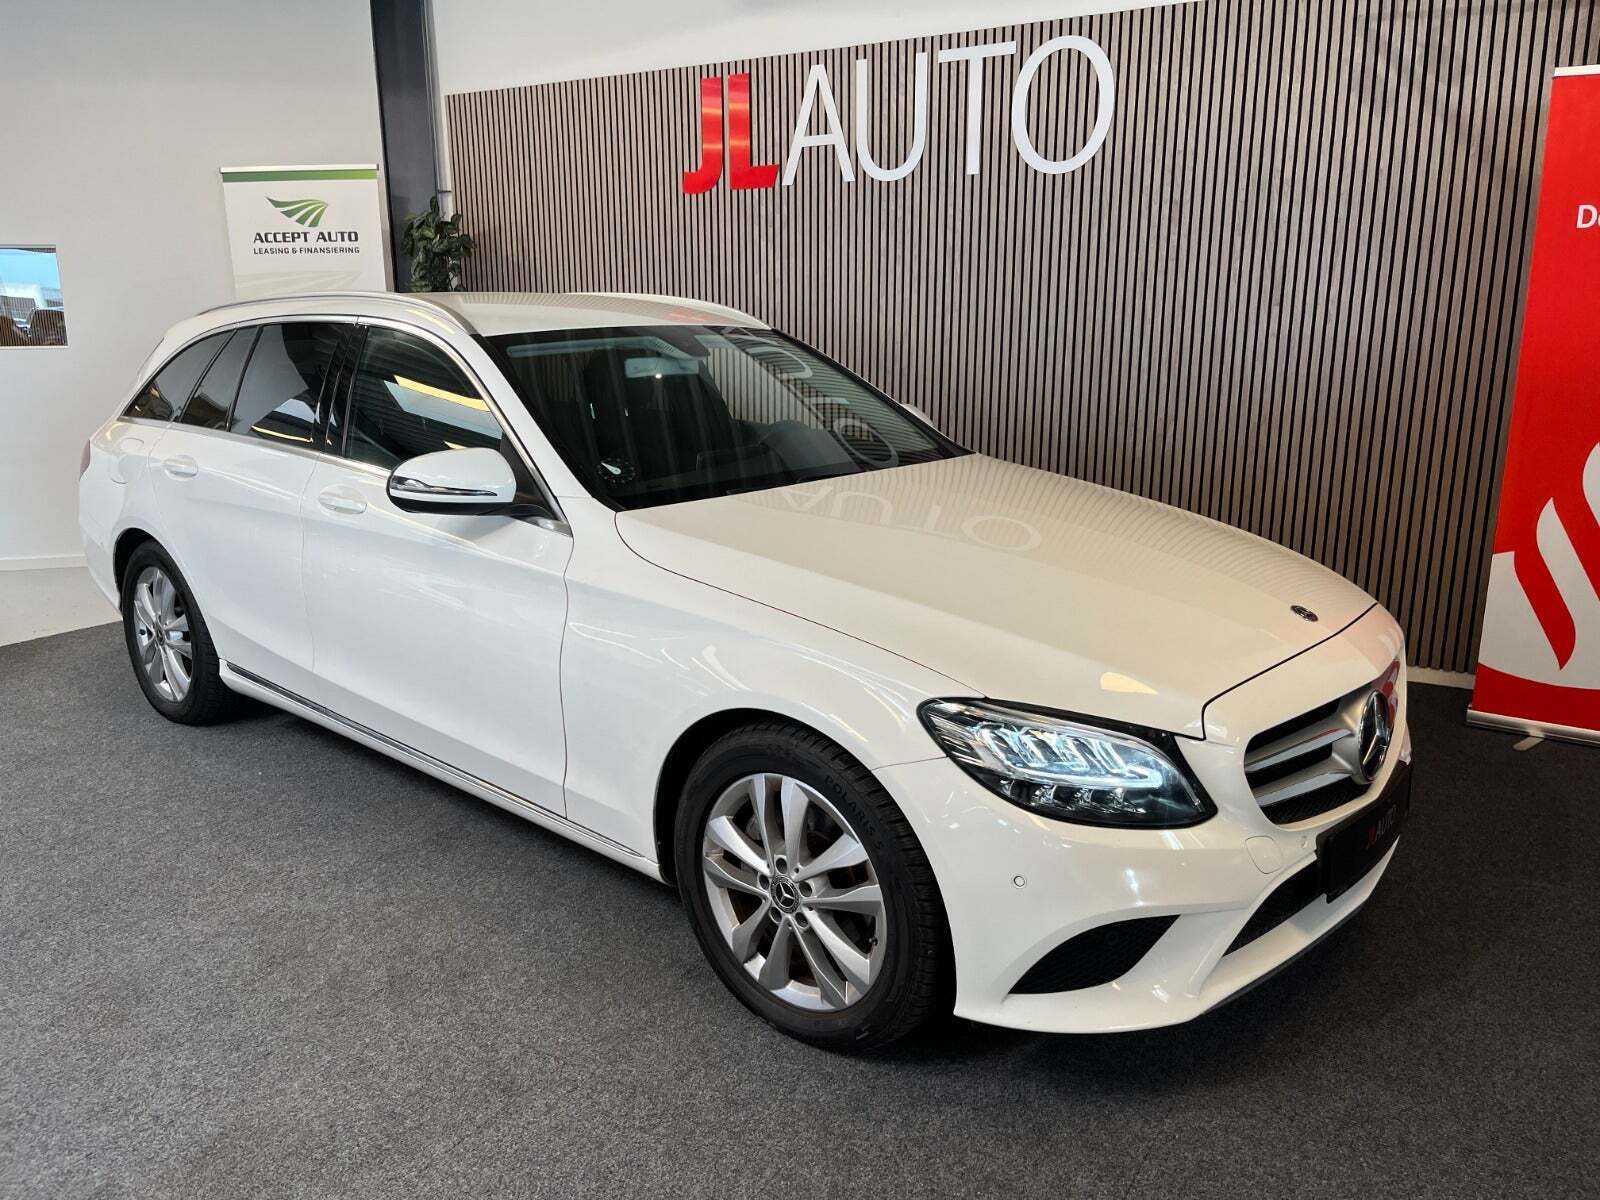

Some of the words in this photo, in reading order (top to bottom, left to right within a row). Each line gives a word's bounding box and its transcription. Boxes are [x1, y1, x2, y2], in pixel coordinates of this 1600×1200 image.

[1576, 204, 1600, 229] D
[253, 231, 310, 243] ACCEPT
[316, 231, 359, 243] AUTO
[253, 247, 290, 255] LEASING
[299, 246, 360, 254] FINANSIERING
[824, 775, 876, 836] POLARIS
